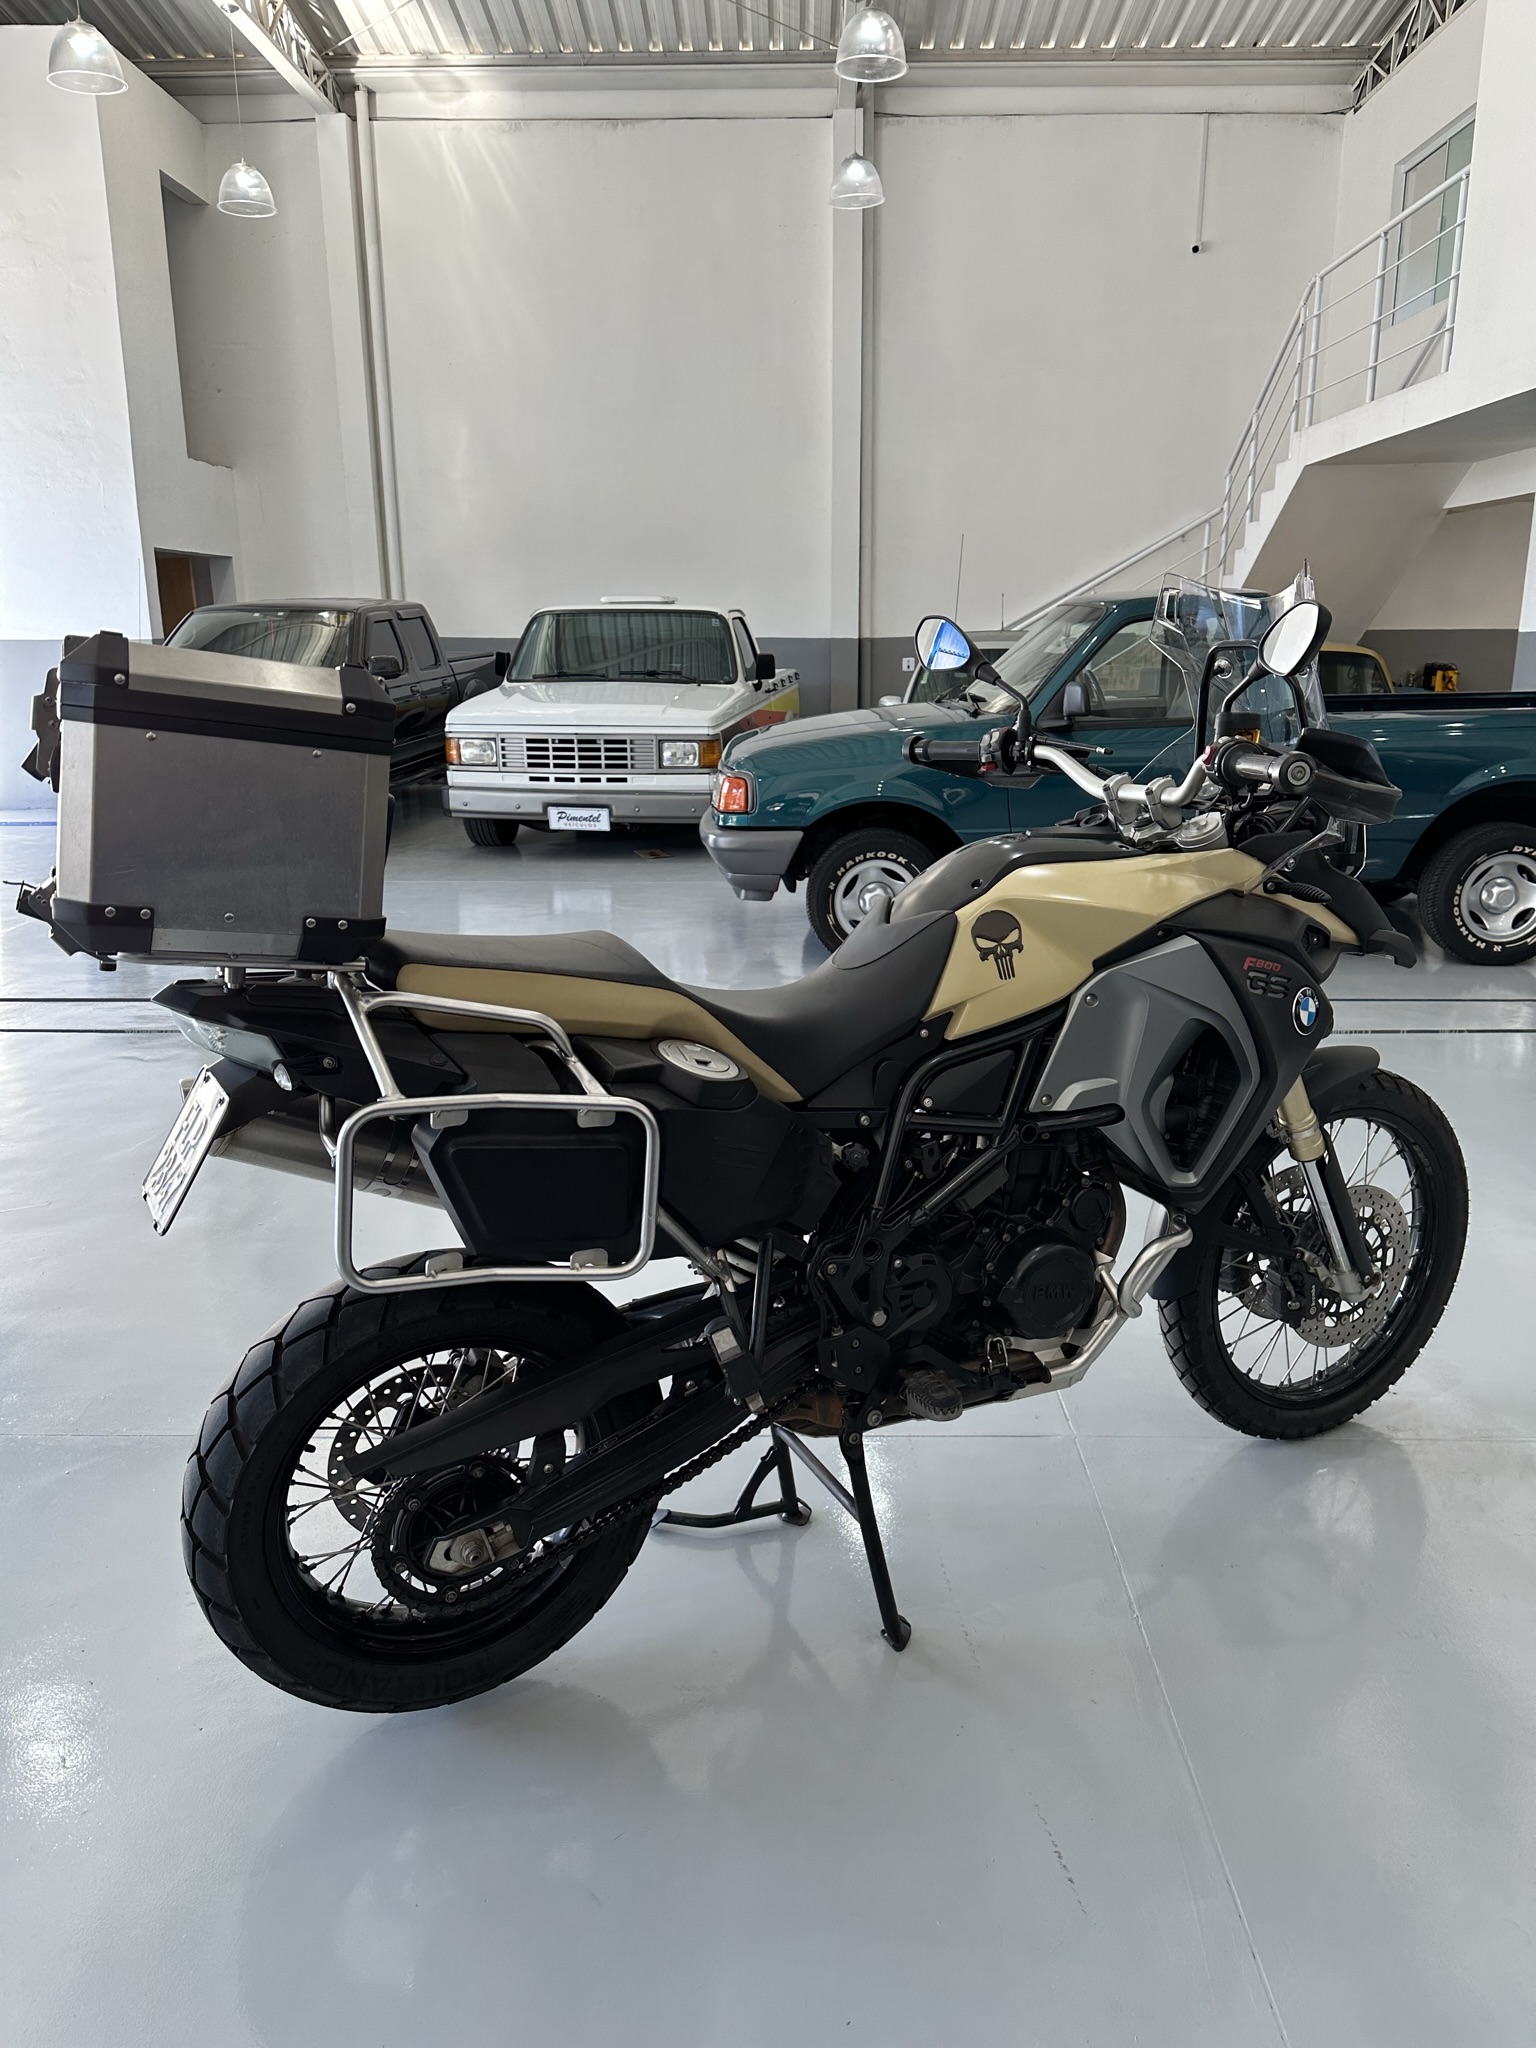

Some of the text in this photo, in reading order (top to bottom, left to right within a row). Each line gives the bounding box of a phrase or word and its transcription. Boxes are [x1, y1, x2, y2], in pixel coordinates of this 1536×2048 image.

[556, 811, 602, 823] Pimentel
[836, 851, 909, 877] HANKOOK
[1453, 884, 1487, 949] HANKOOK
[1243, 956, 1282, 972] F800
[1246, 971, 1292, 999] GS
[1033, 1284, 1074, 1301] BMW
